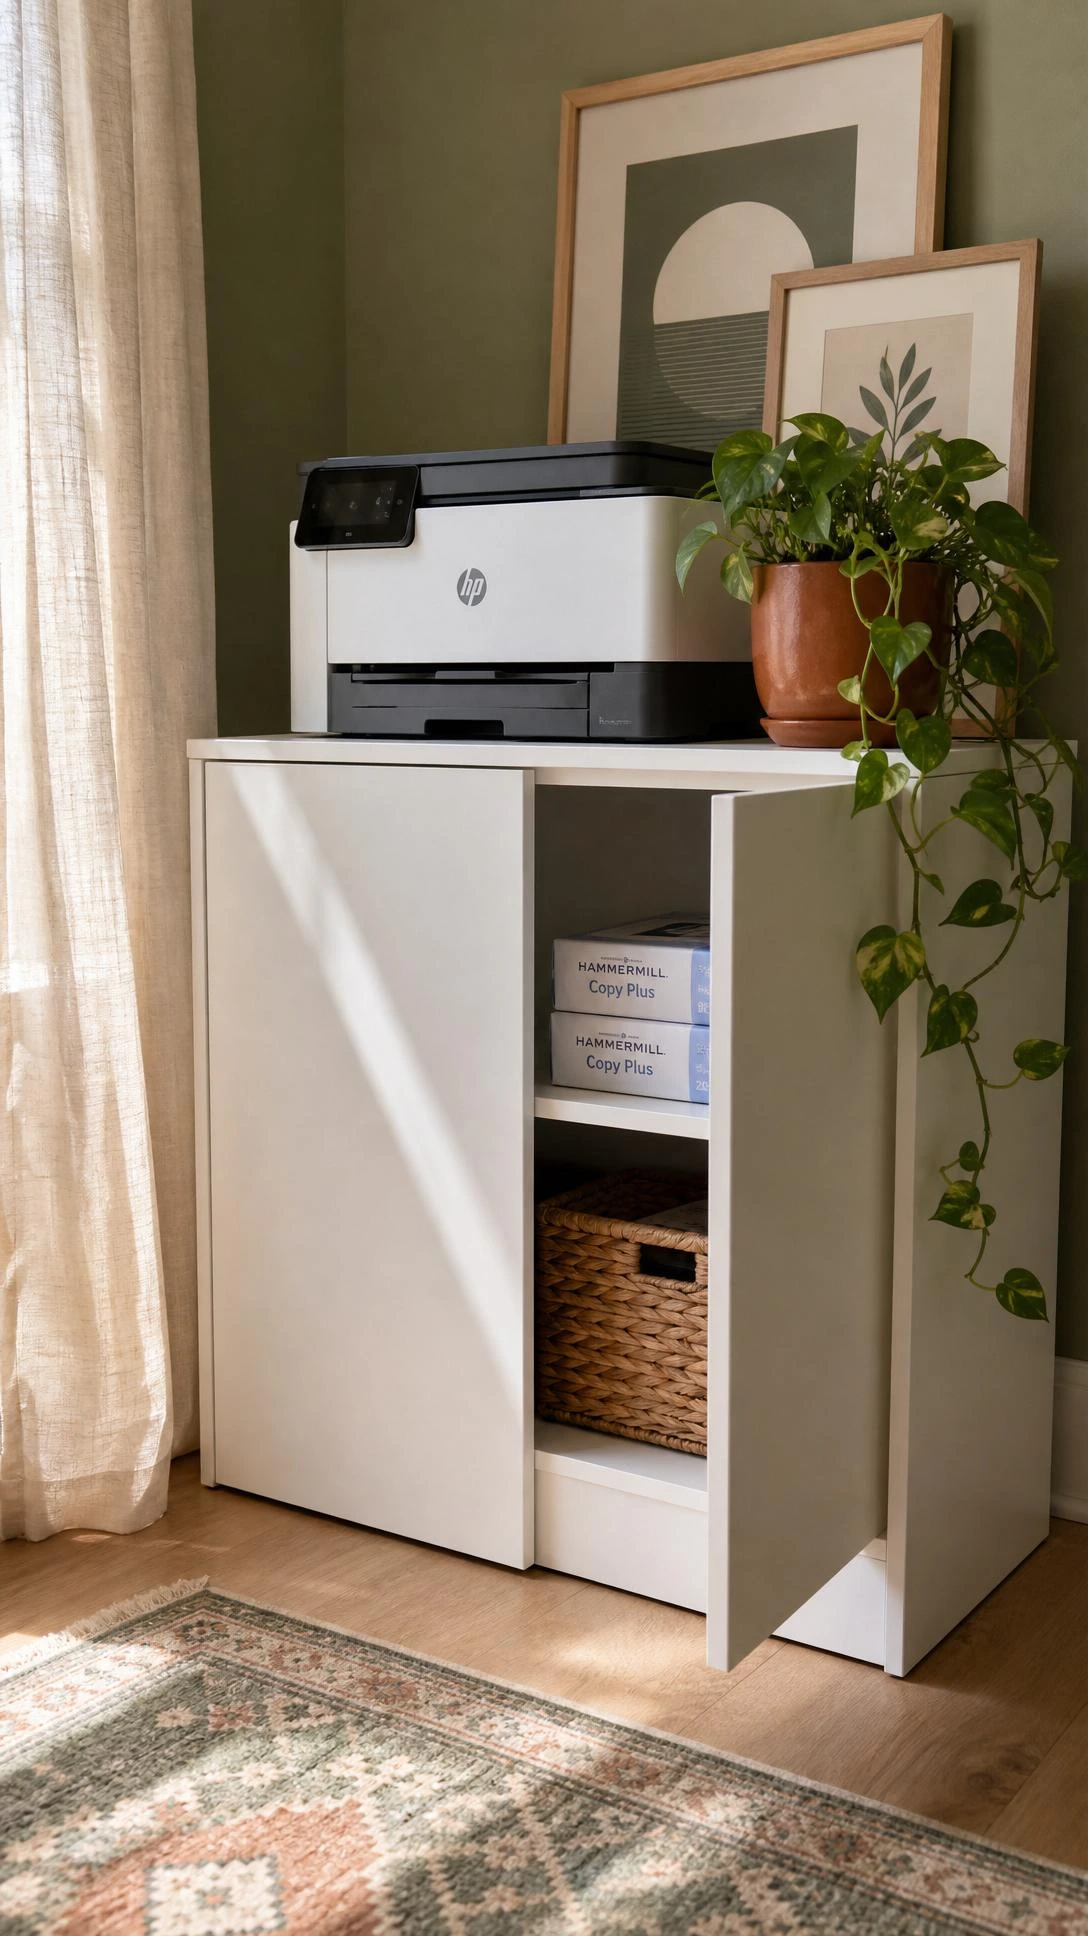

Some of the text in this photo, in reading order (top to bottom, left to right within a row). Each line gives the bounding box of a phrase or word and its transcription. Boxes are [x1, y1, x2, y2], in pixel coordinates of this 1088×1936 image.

[458, 568, 487, 606] hp
[589, 980, 655, 999] Copy Plus
[586, 1055, 653, 1076] Copy Plus
